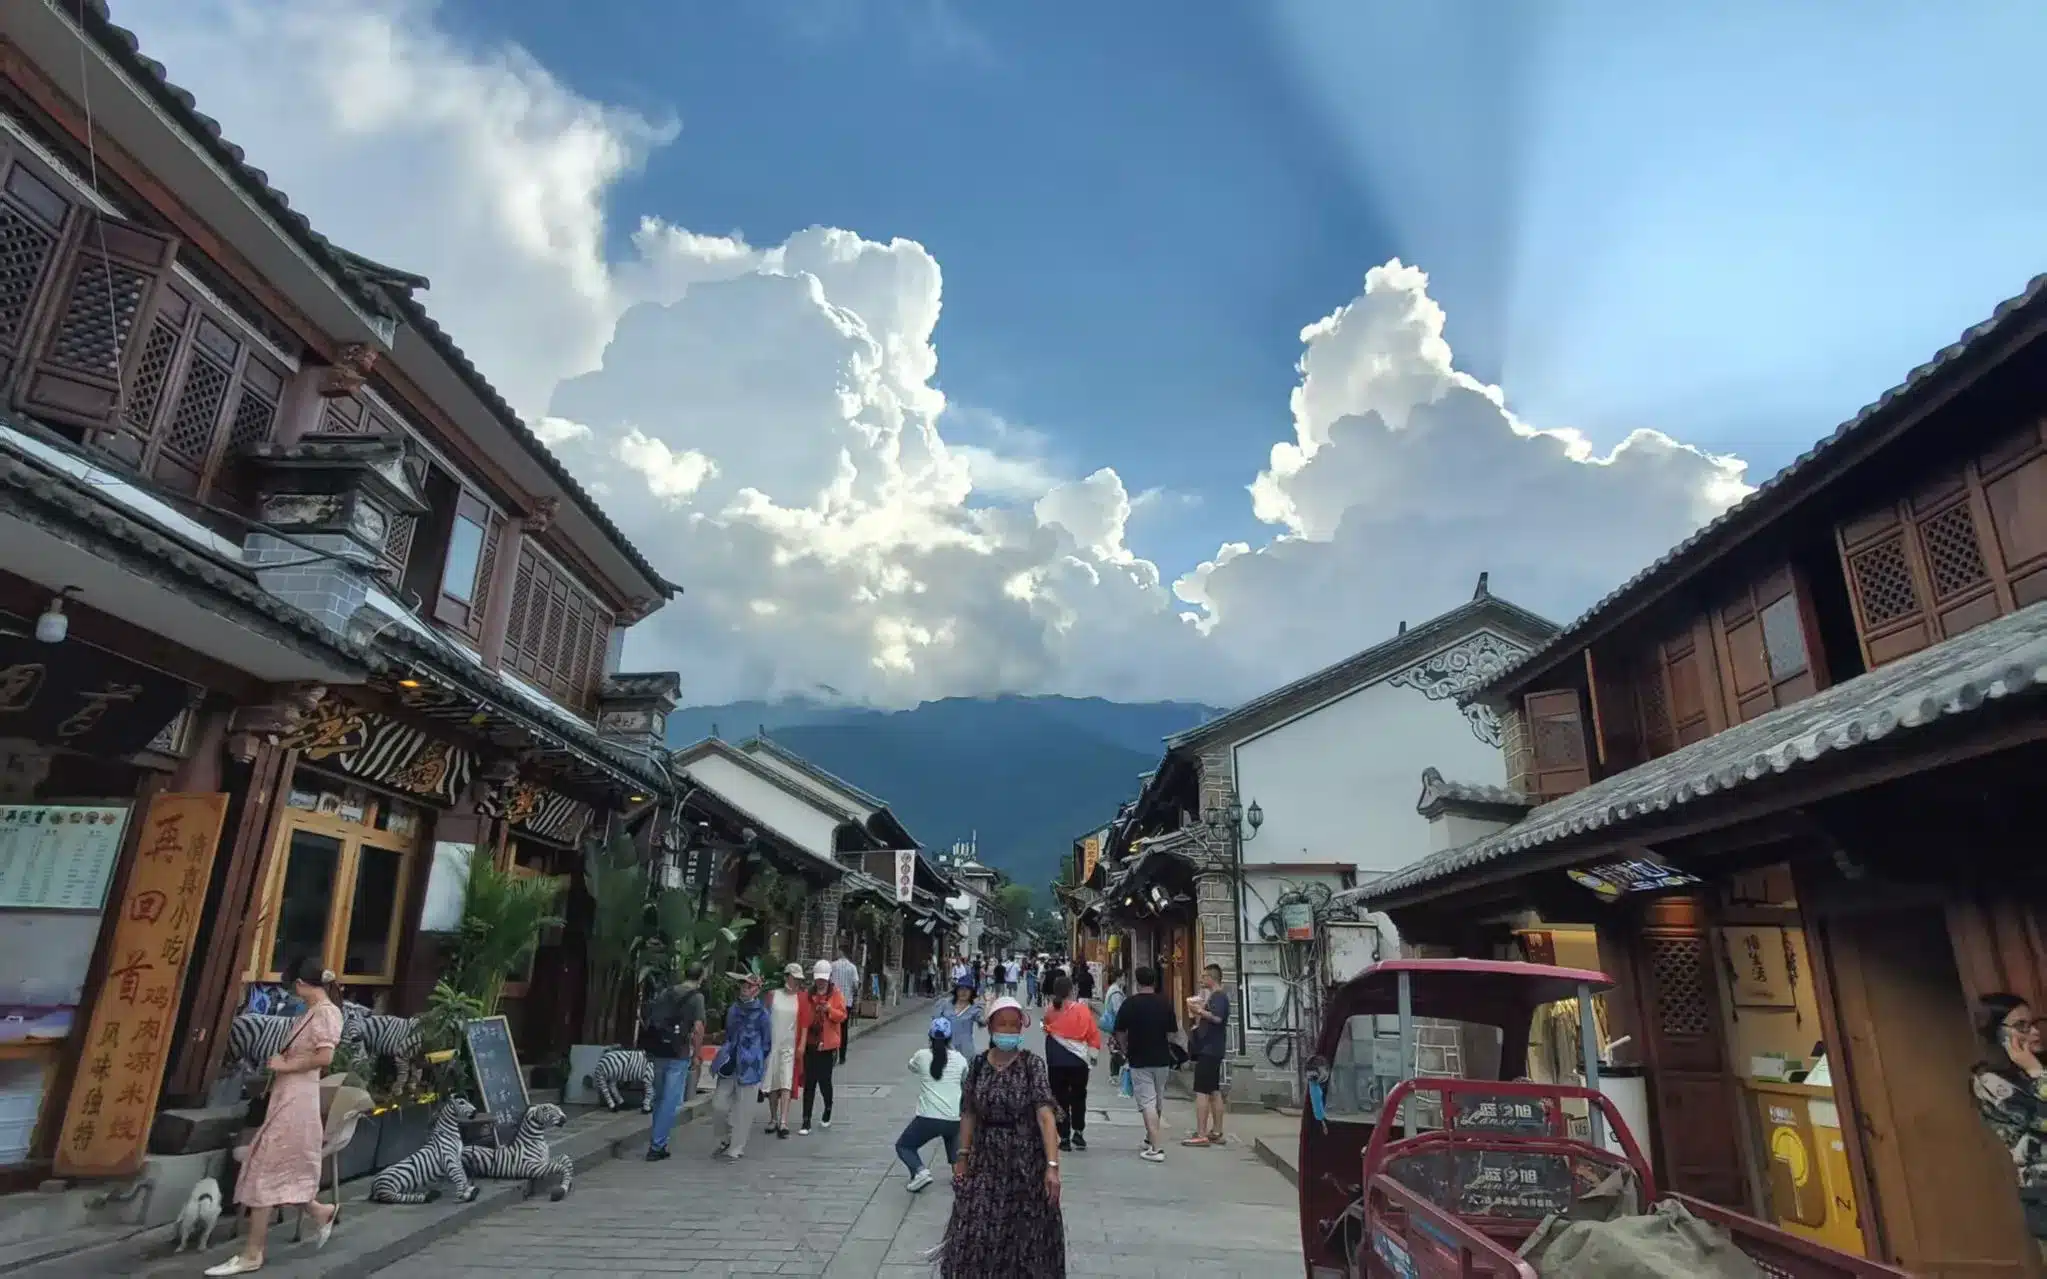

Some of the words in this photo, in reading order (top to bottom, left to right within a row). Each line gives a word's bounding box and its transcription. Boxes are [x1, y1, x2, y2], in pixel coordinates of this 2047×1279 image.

[109, 813, 184, 1005] 再回首
[160, 832, 207, 966] 清真小吃
